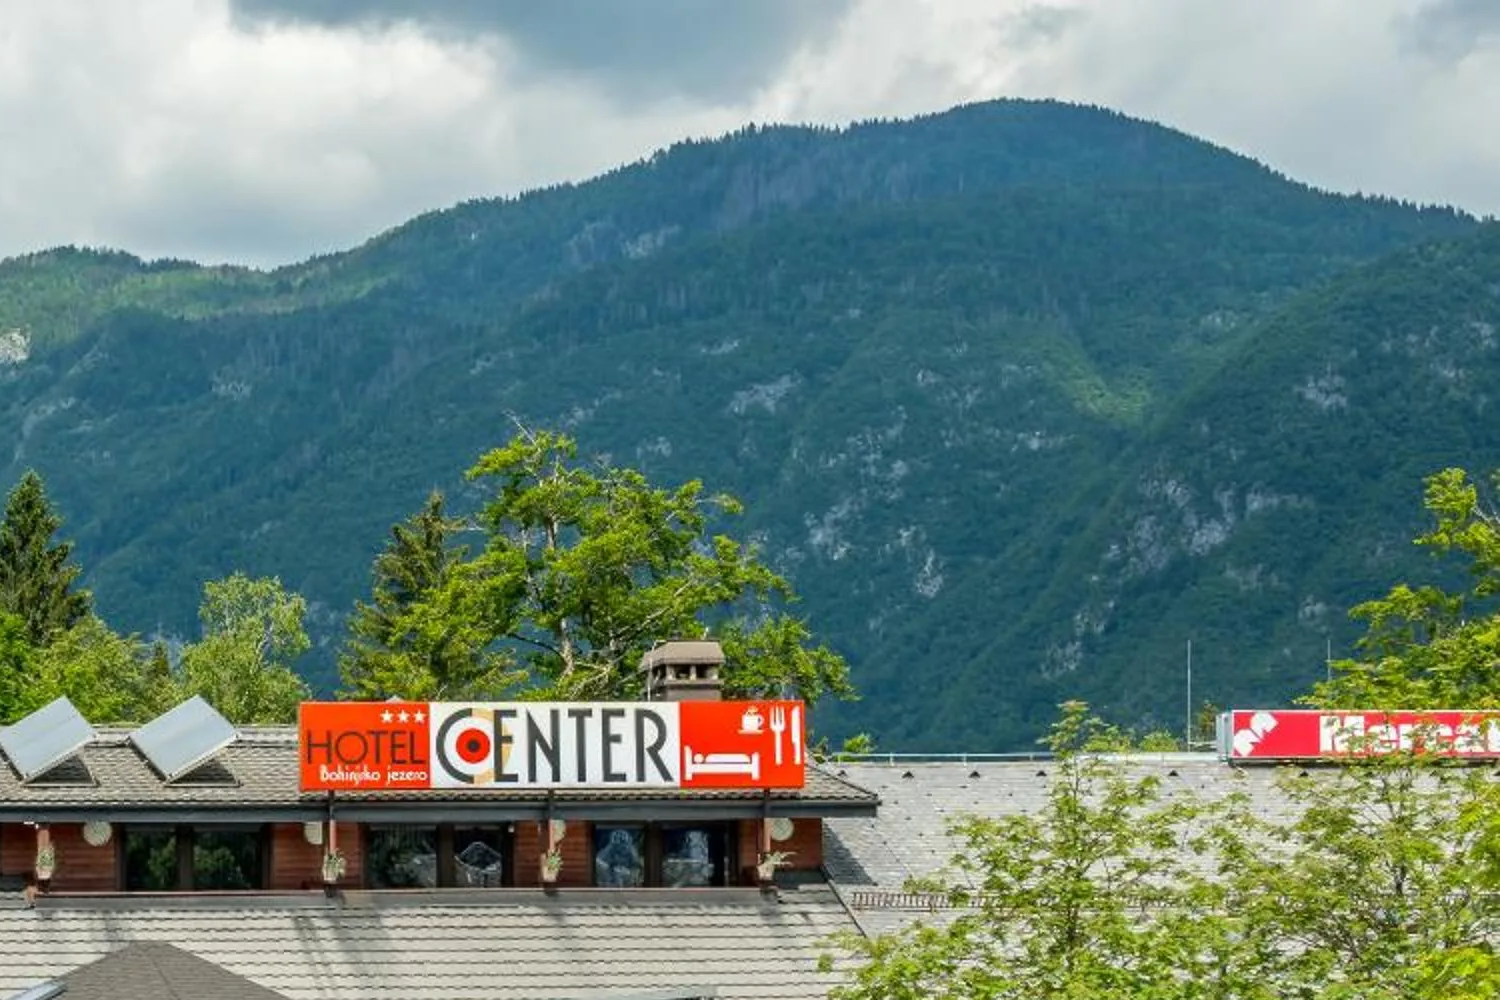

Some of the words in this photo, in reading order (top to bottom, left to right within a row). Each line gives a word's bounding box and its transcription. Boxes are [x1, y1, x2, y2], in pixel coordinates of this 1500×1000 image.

[307, 730, 426, 764] HOTEL
[435, 707, 674, 784] CENTER
[386, 764, 429, 786] jezero
